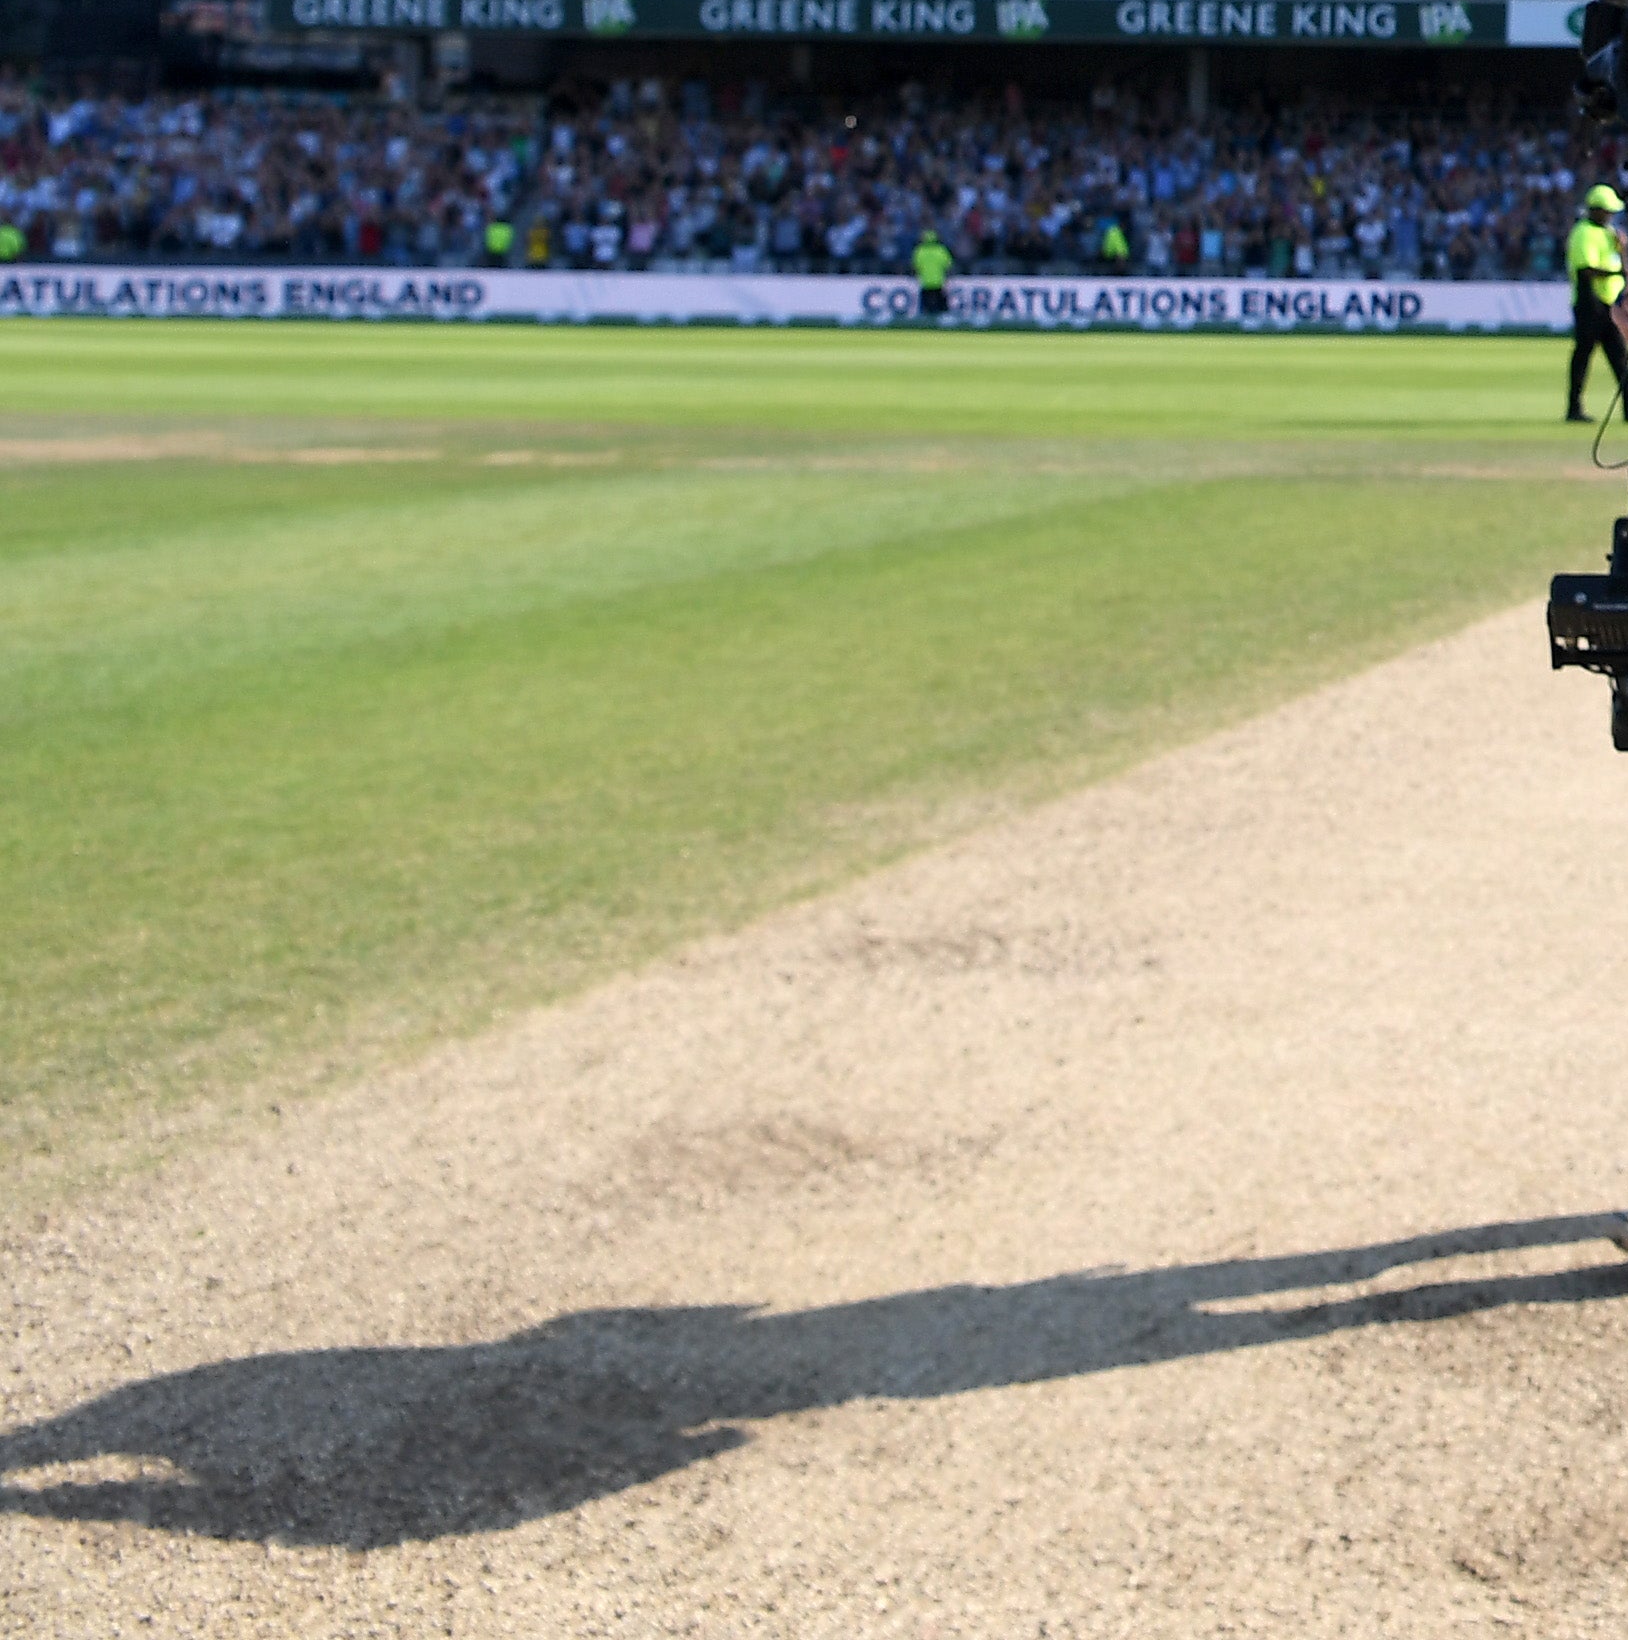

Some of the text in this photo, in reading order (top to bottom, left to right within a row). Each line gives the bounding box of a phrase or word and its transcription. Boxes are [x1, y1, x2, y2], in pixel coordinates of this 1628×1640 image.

[1116, 0, 1473, 42] GREENE KING IPA
[283, 279, 484, 307] ENGLAND
[862, 286, 1423, 320] COGRATULATIONS ENGLAND
